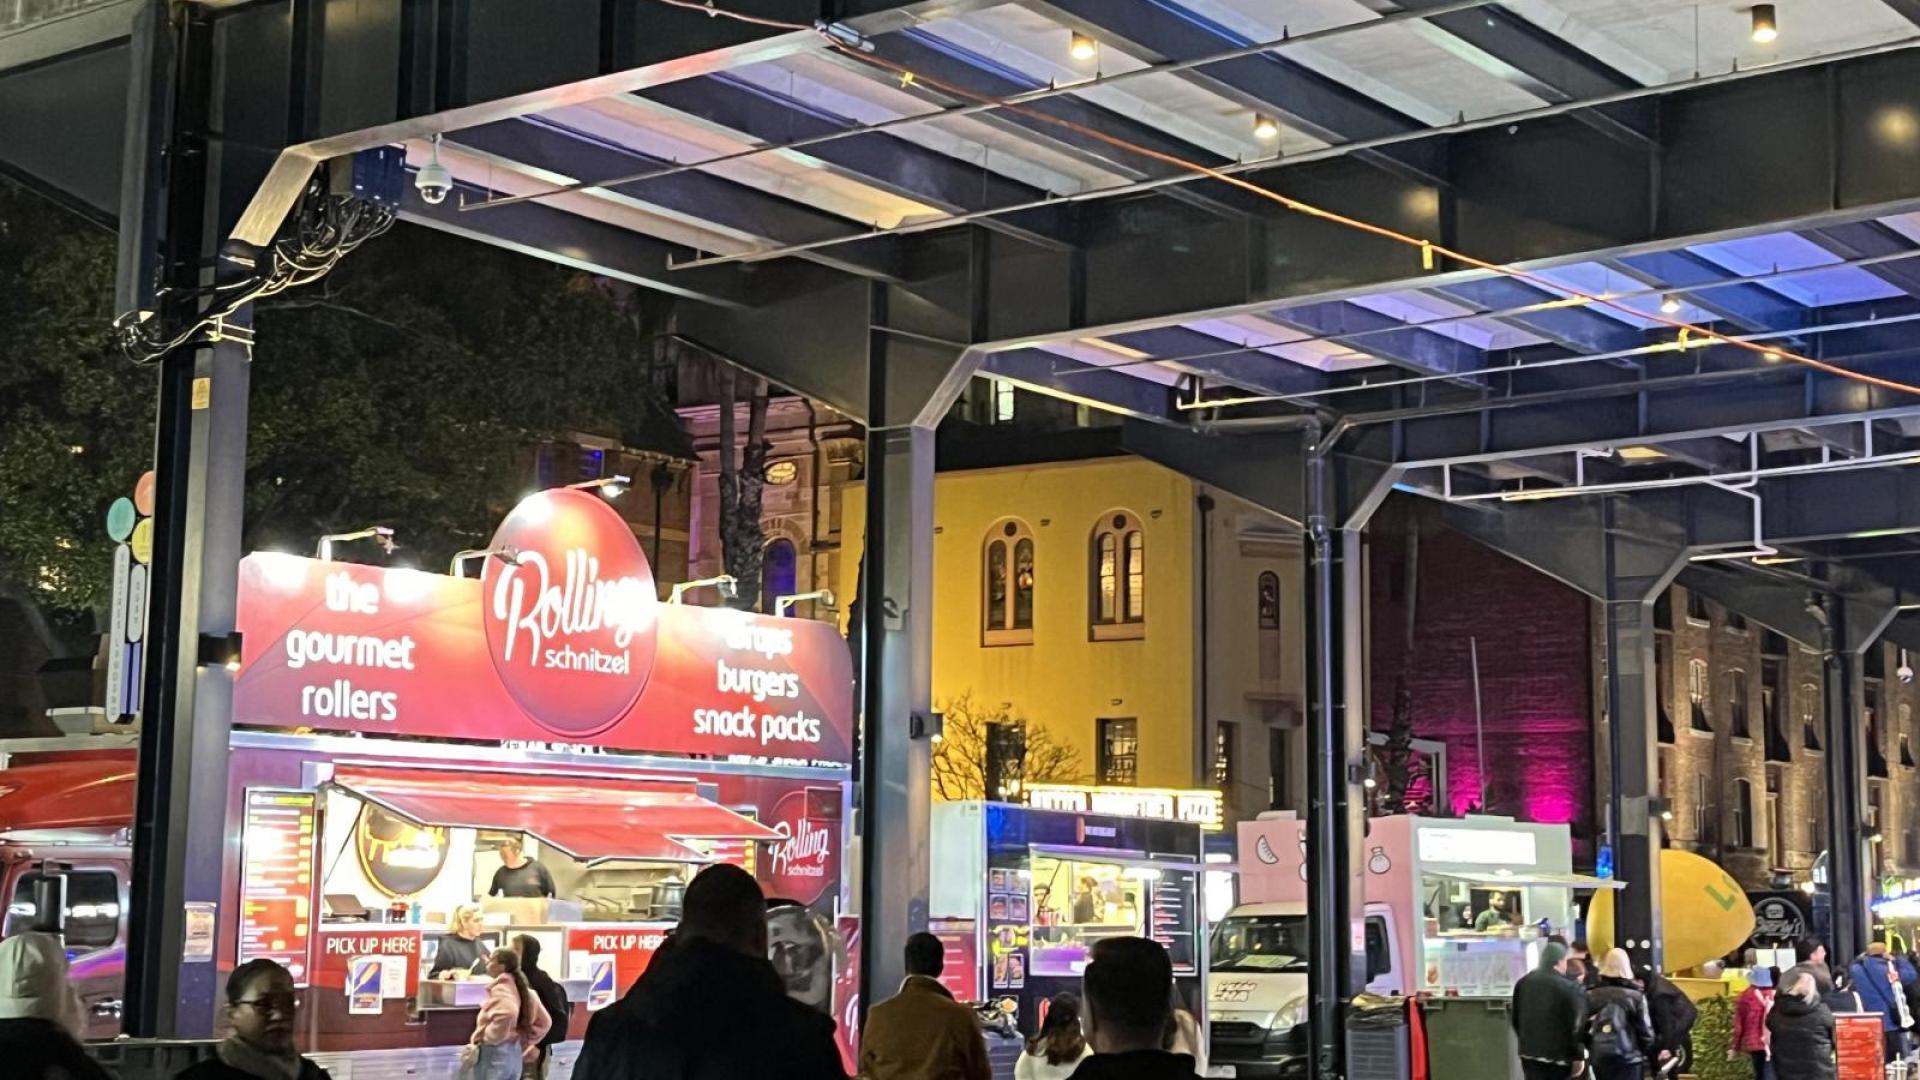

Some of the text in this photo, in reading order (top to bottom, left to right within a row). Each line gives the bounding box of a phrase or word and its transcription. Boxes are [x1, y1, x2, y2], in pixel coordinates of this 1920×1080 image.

[325, 571, 380, 614] the
[493, 548, 650, 667] Rolling
[286, 629, 416, 671] gourmet
[545, 645, 630, 675] schnitzel
[302, 679, 398, 721] rollers
[717, 658, 800, 702] burgers
[767, 817, 830, 875] Rolling
[326, 936, 417, 955] PICK UP HERE
[593, 935, 619, 951] PICK
[620, 935, 637, 951] UP
